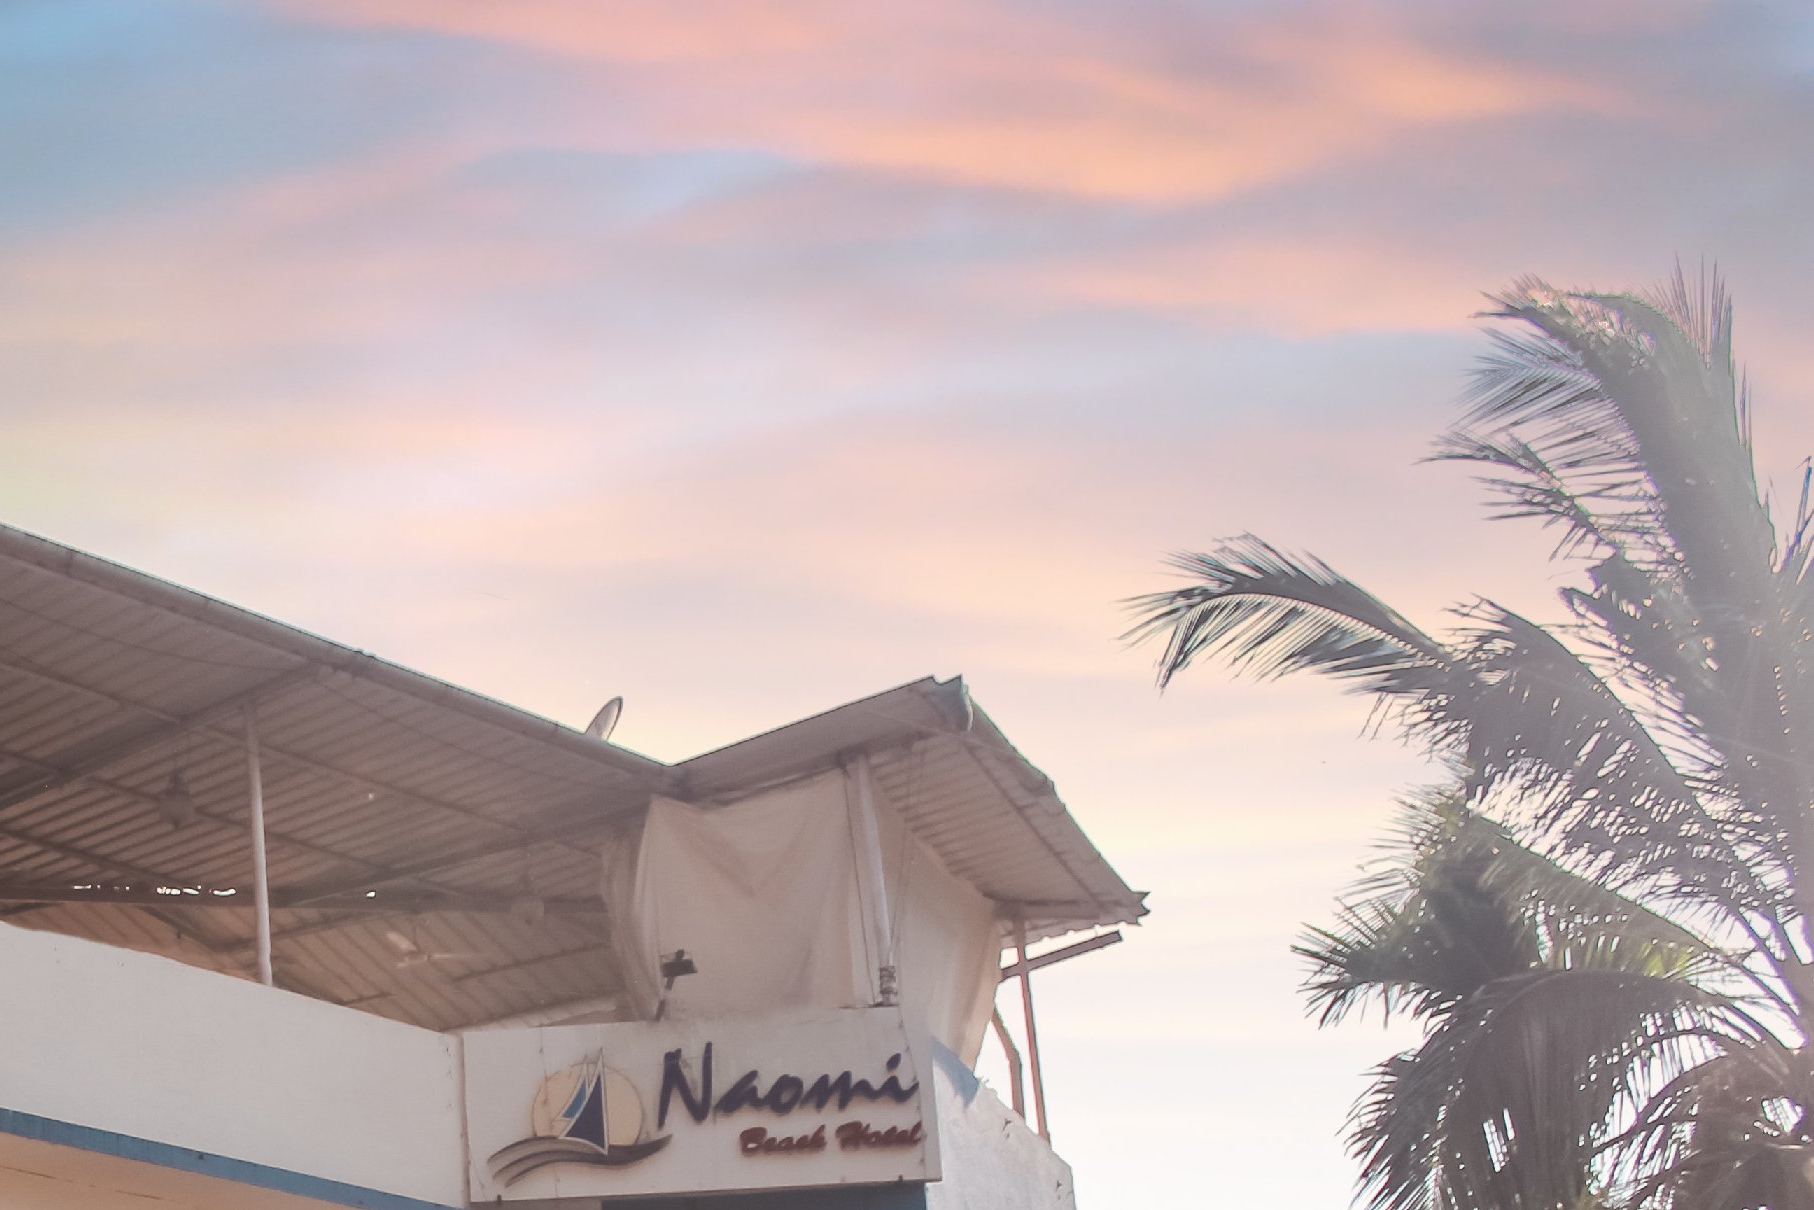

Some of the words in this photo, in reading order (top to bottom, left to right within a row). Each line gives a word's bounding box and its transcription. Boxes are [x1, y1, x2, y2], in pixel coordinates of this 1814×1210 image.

[658, 1041, 919, 1129] Naomi
[740, 1124, 827, 1156] Beach
[836, 1120, 922, 1149] Hotel
